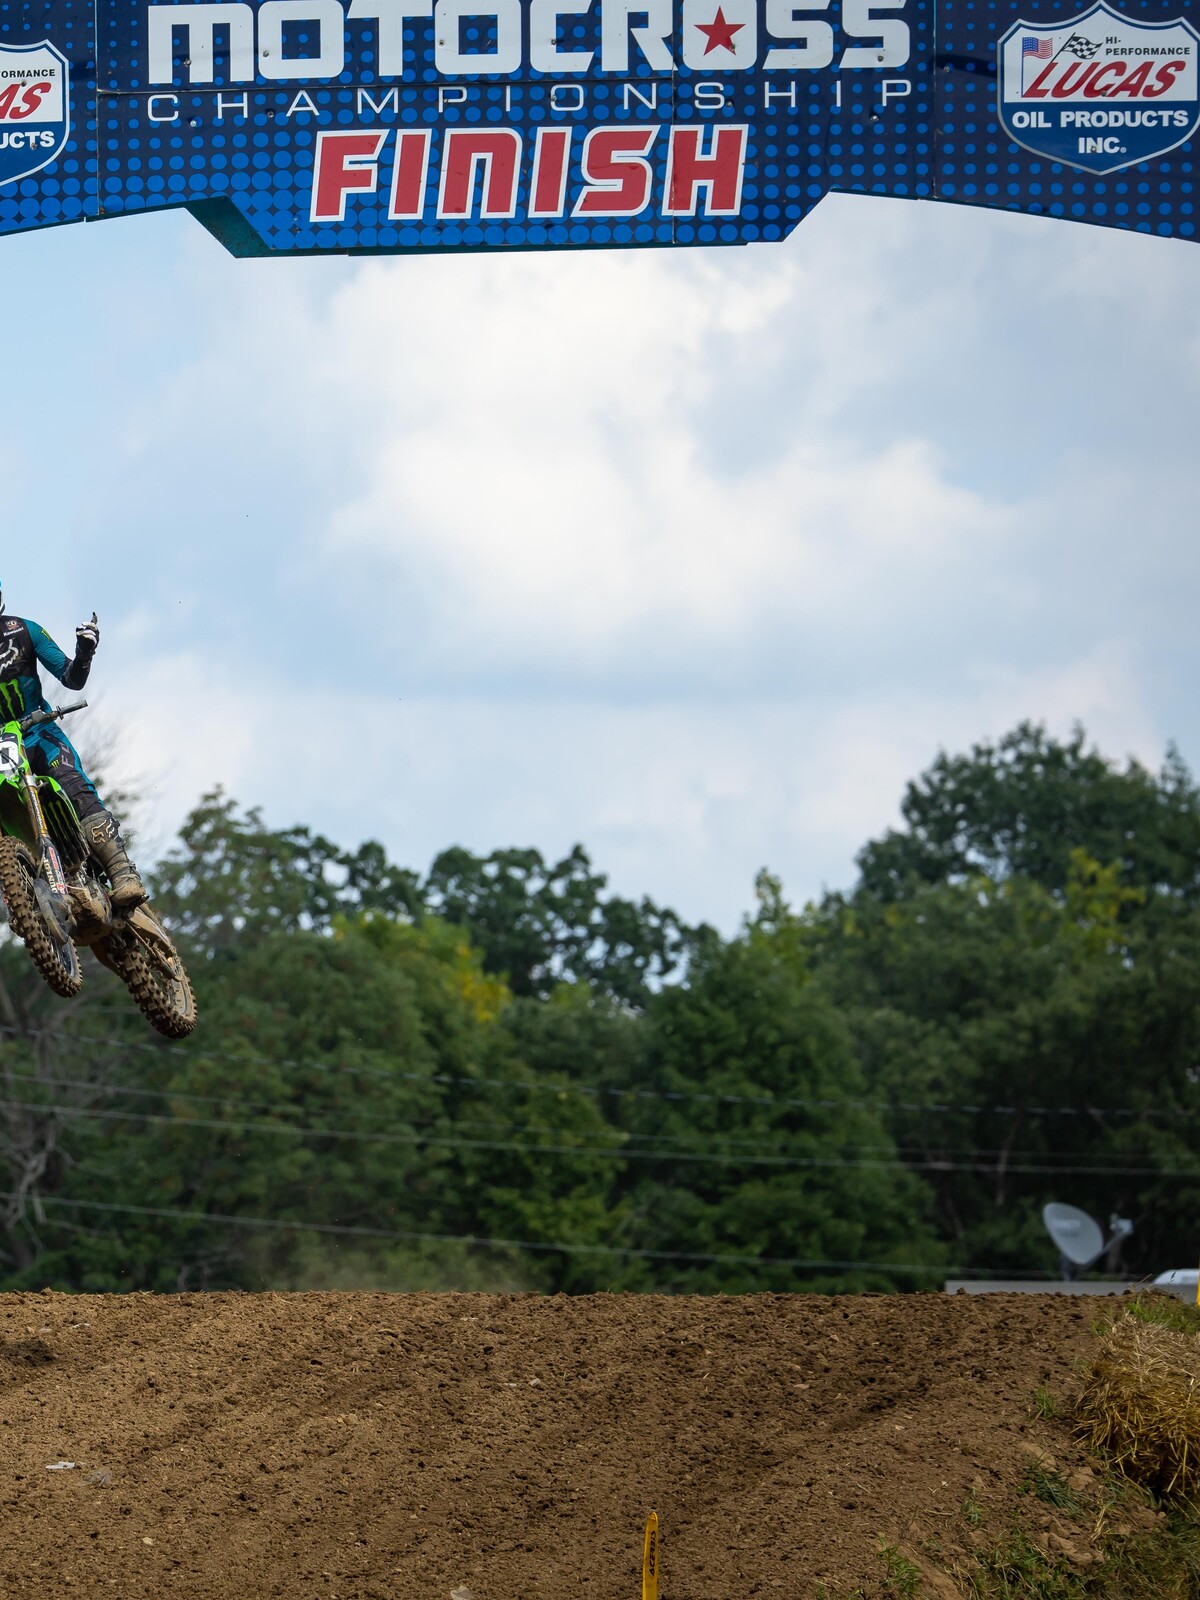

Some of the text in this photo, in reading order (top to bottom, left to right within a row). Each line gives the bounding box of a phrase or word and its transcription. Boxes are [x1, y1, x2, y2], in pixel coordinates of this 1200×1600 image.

[148, 0, 911, 84] MOTOCROSS
[1105, 36, 1121, 44] HI-
[1105, 47, 1191, 56] PERFORMANCE
[1021, 60, 1186, 98] LUCAS
[148, 79, 912, 122] CHAMPIONSHIP
[1012, 110, 1189, 128] OIL PRODUCTS
[309, 124, 749, 223] FINISH
